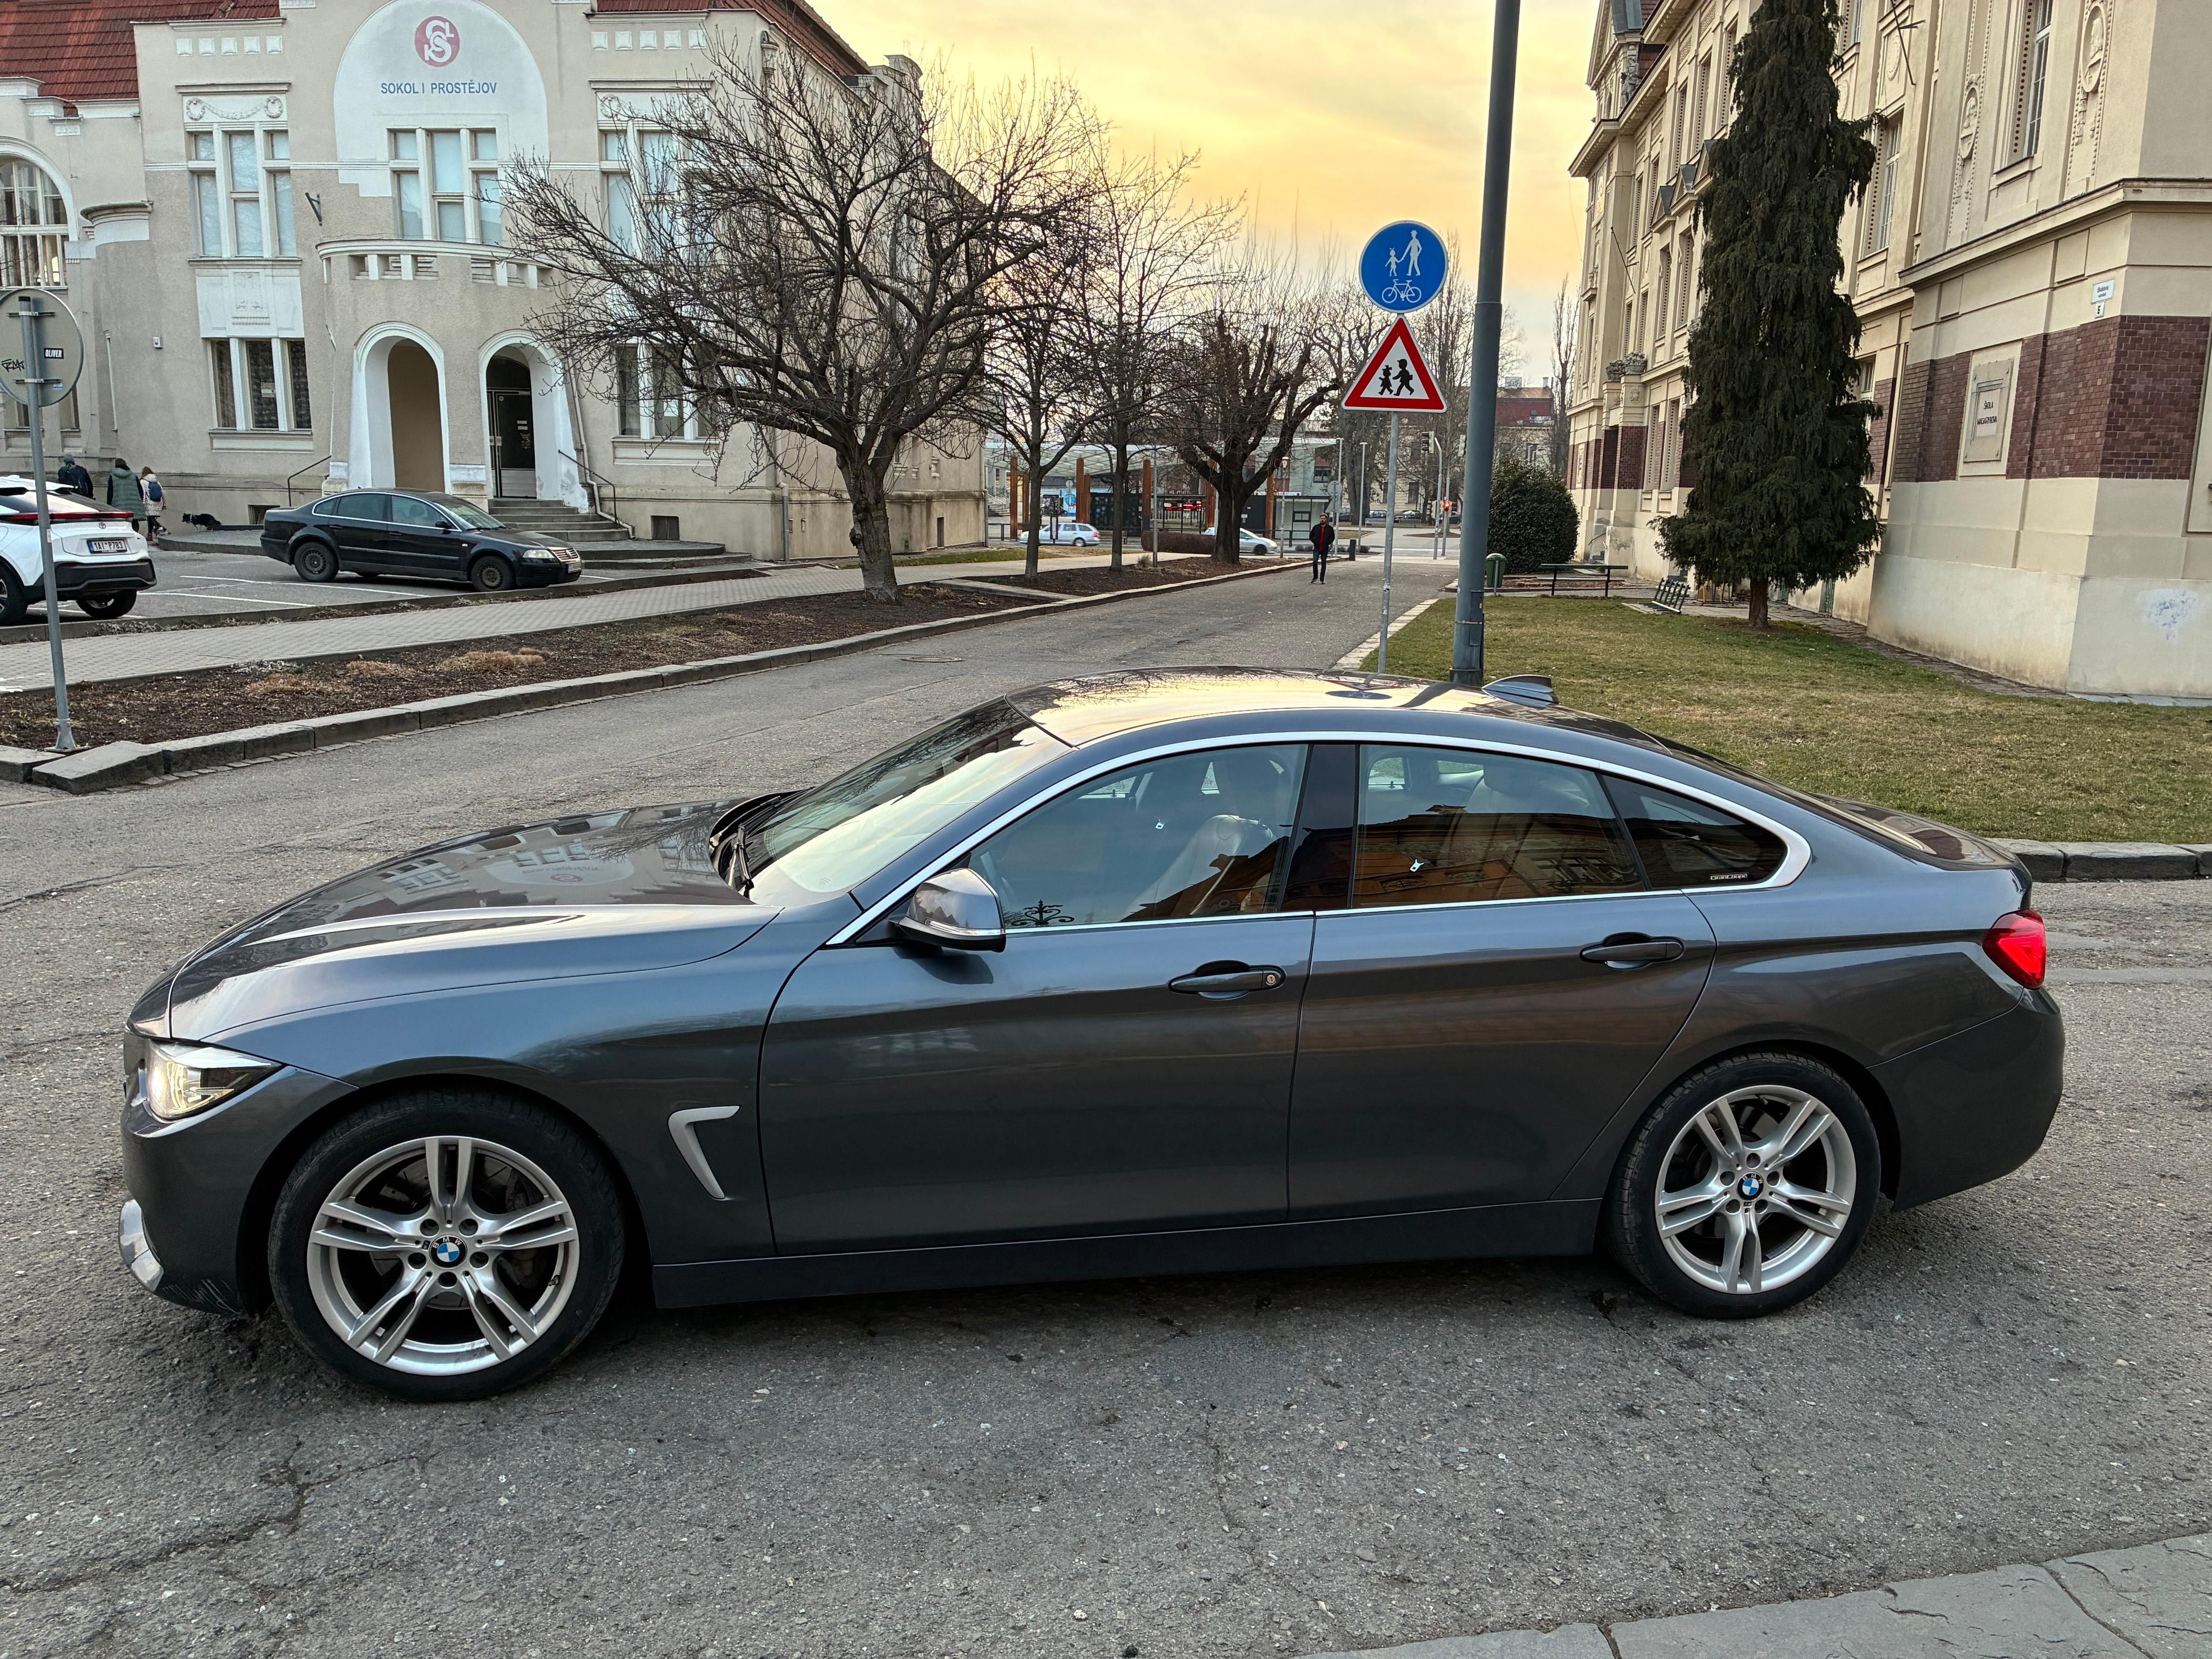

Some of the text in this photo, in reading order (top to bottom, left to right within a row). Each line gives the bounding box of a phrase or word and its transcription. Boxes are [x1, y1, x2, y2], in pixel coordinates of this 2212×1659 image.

[381, 79, 497, 94] SOKOL I PROSTĚJOV
[45, 349, 62, 358] OLIVER
[1984, 400, 1994, 409] ŠKOLA
